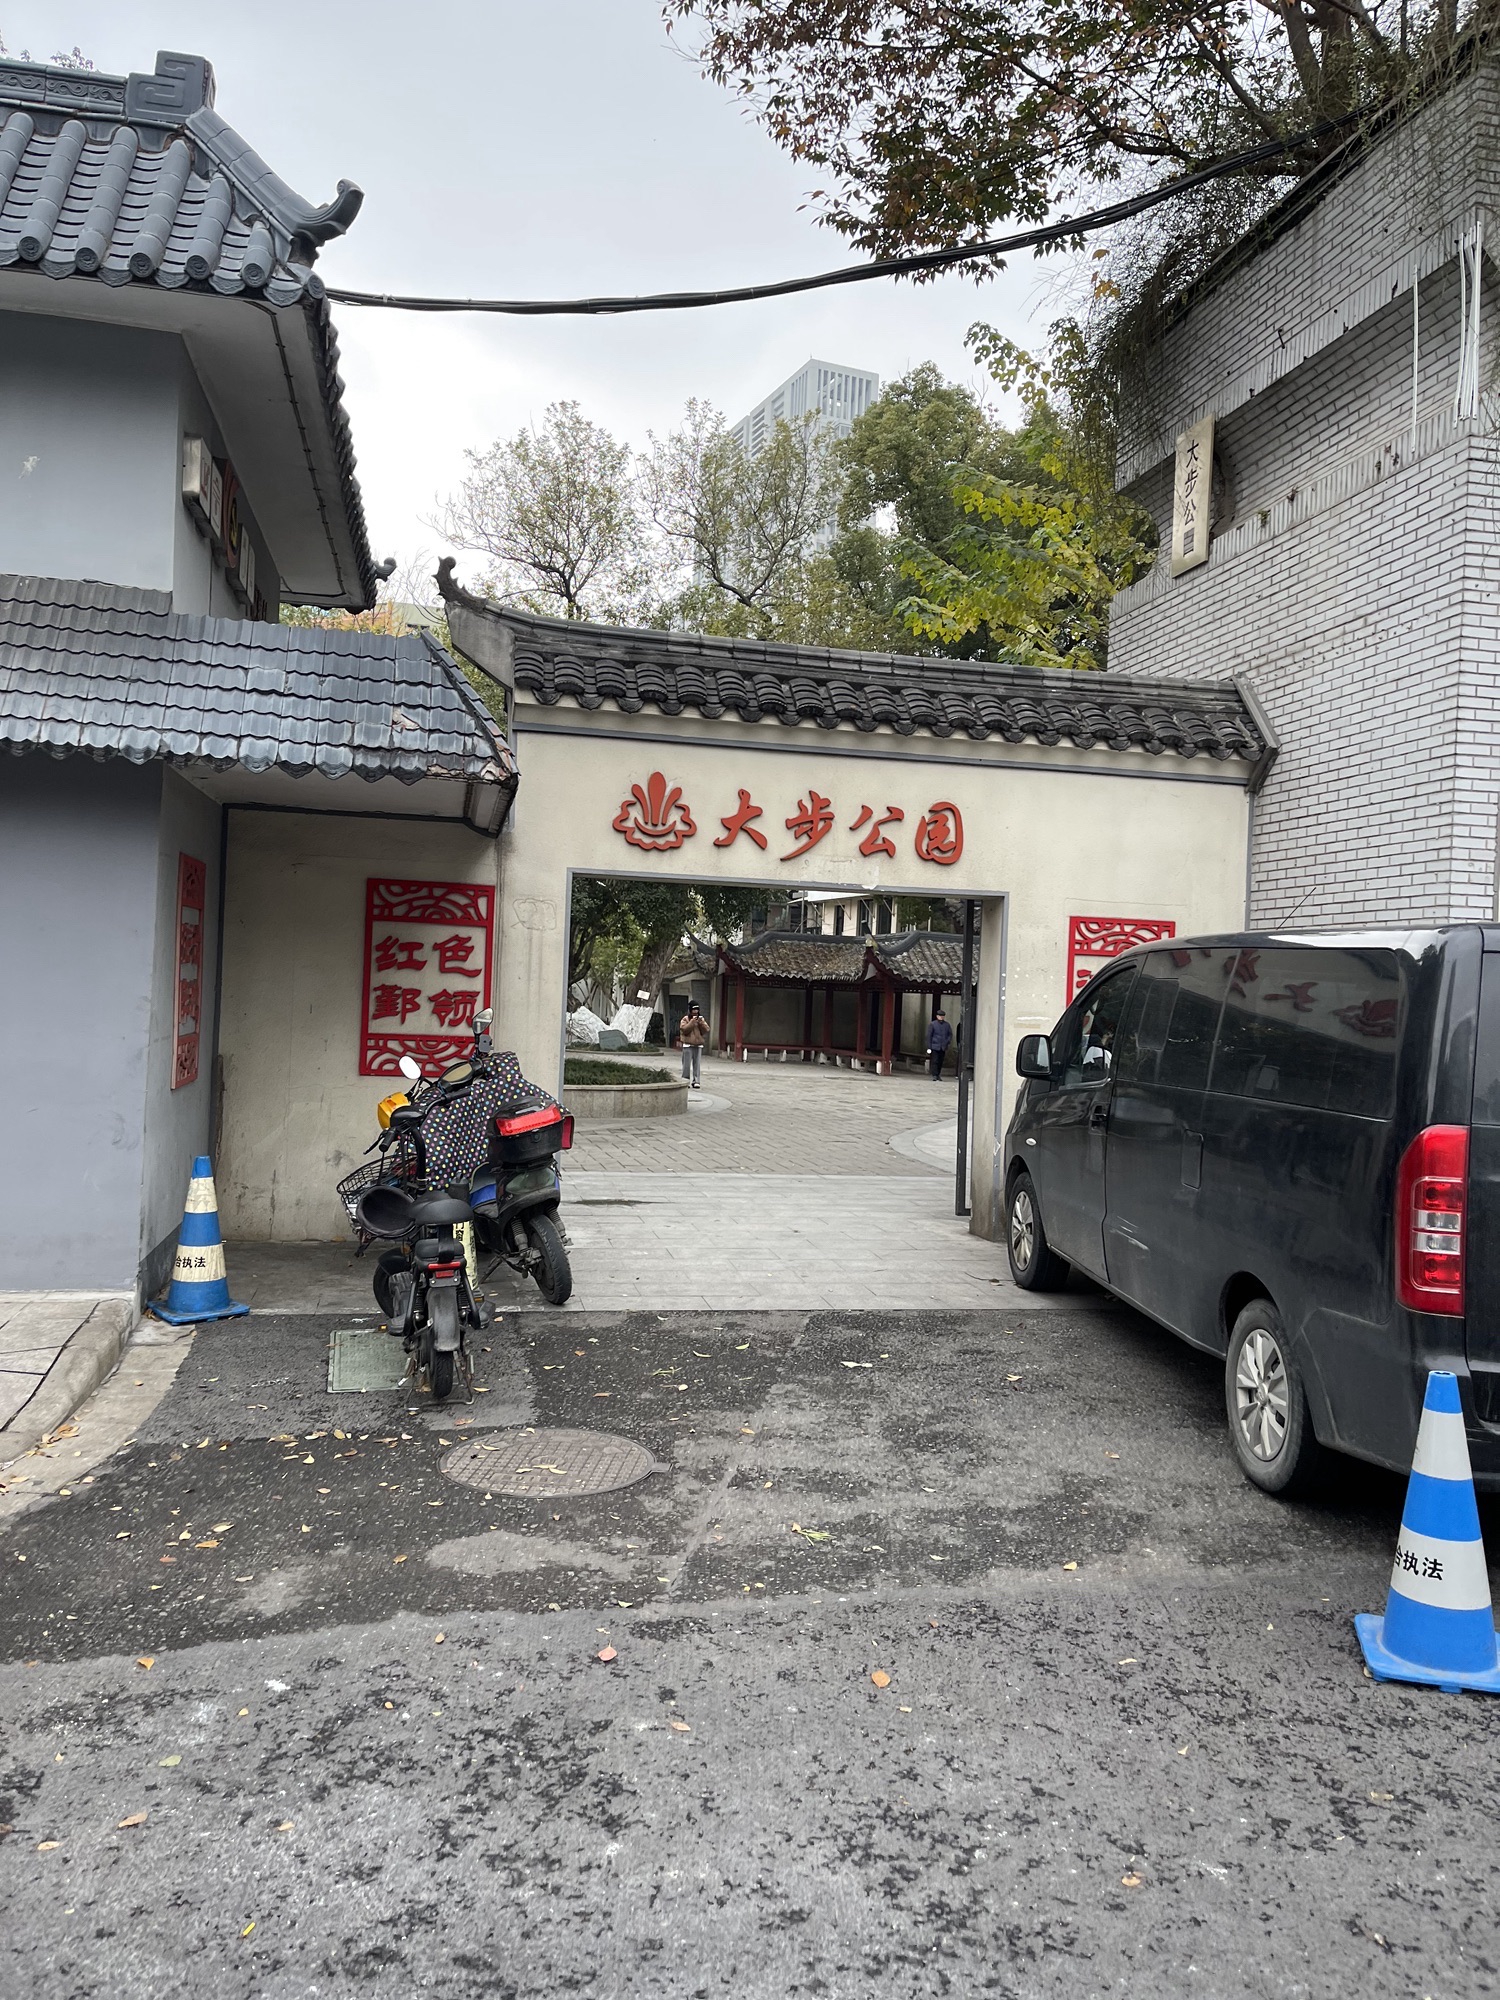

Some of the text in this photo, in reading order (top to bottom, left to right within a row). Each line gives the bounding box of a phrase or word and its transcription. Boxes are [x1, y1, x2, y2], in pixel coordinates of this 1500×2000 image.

[713, 788, 964, 865] 大步公园
[375, 934, 482, 977] 红色
